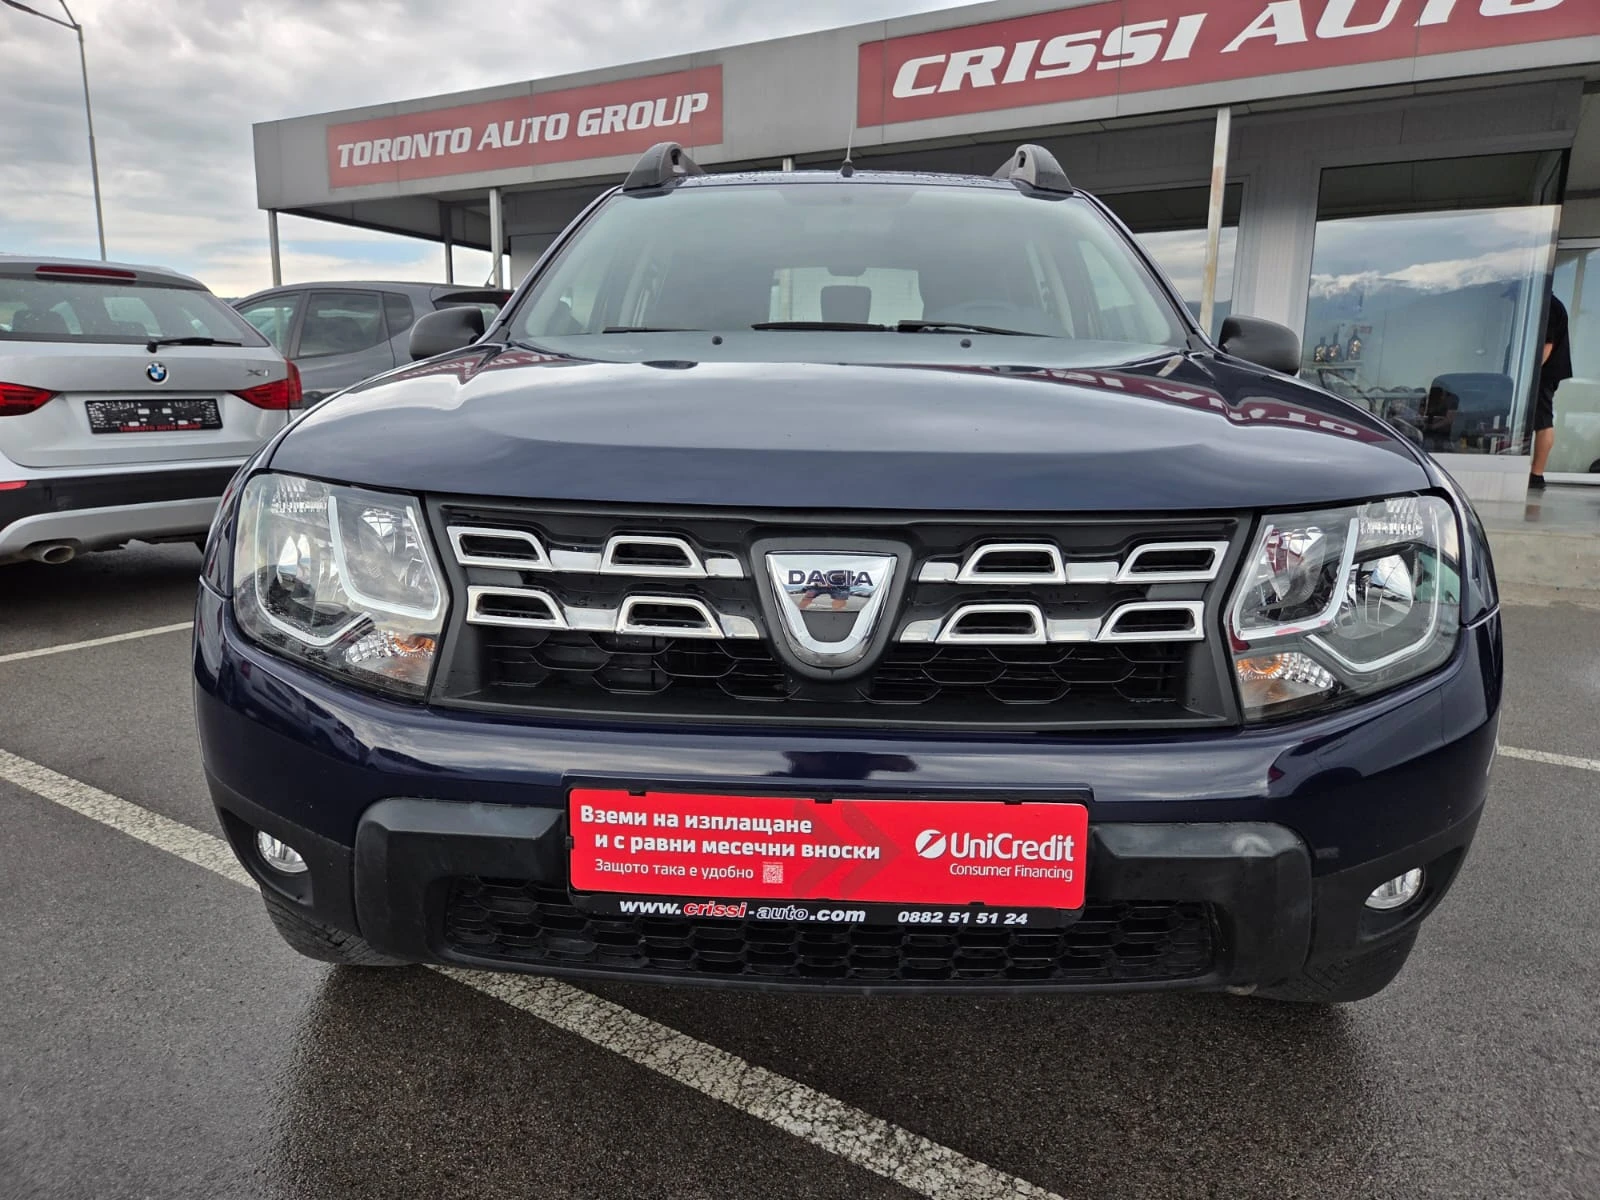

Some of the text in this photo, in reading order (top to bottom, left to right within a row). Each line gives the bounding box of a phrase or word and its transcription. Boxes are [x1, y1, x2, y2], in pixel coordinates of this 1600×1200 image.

[893, 0, 1567, 99] CRISSI AU
[337, 92, 710, 169] TORONTO AUTO GROUP
[788, 570, 874, 587] DACIA
[580, 805, 813, 836] Вземи на изплащане
[594, 833, 880, 860] и с равни месечни вноски
[950, 831, 1075, 862] UniCredit
[594, 858, 754, 881] Защото така е удобно
[949, 862, 1073, 882] Consumer Financing
[619, 900, 867, 924] www.crissi-auto.com
[897, 910, 1029, 926] 0882 51 51 24
